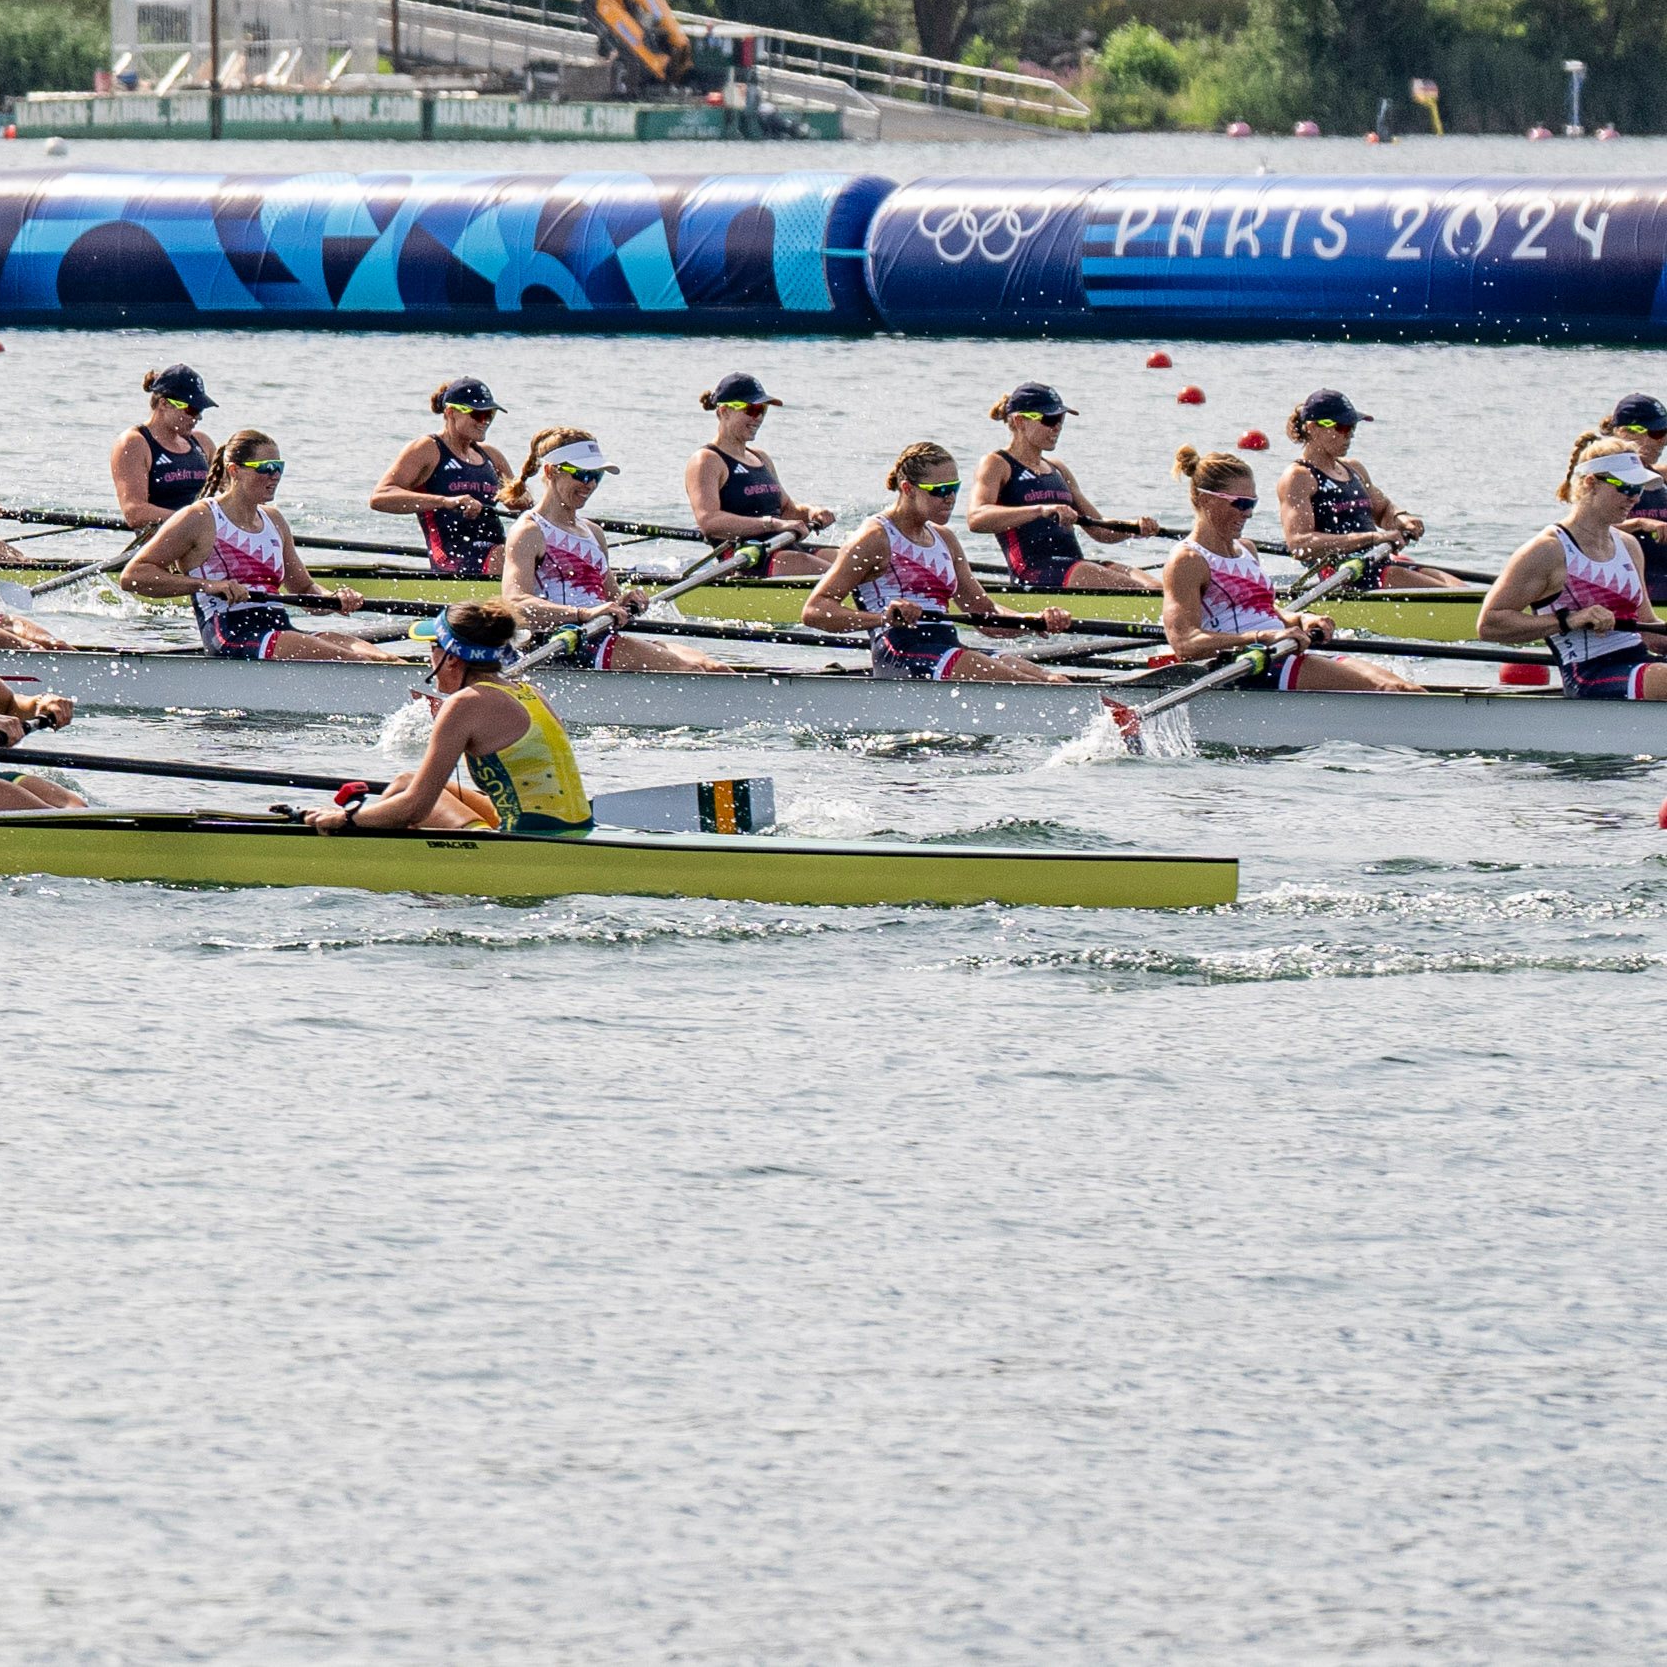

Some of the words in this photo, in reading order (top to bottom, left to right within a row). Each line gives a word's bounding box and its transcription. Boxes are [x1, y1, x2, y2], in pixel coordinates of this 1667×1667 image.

[1386, 200, 1612, 260] 2024
[469, 648, 486, 659] NK
[426, 840, 480, 850] EMPACHER
